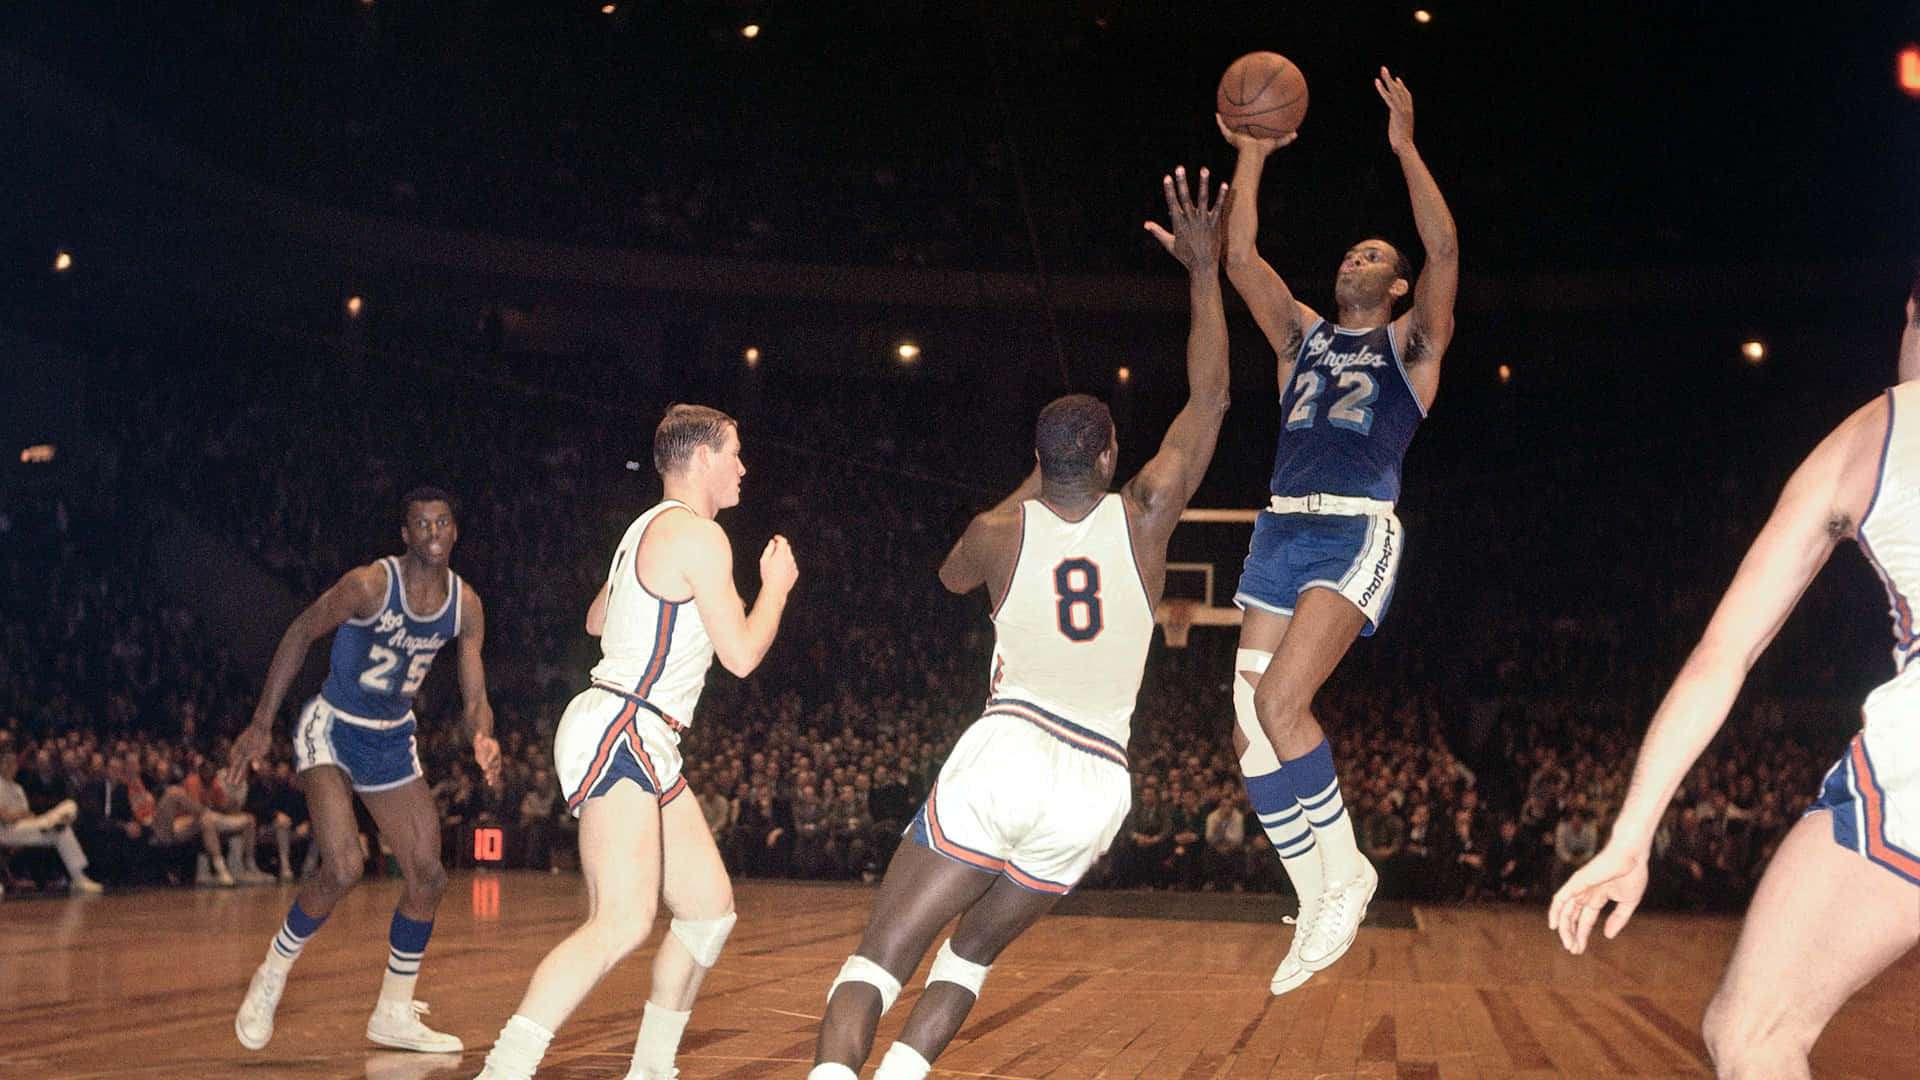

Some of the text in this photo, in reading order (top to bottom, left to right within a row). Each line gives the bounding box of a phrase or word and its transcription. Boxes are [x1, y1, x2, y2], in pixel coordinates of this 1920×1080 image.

[1304, 332, 1333, 360] Los
[1285, 368, 1380, 436] 22
[1358, 518, 1395, 608] LAKERS
[375, 608, 404, 633] Los
[1053, 556, 1104, 643] 8
[359, 644, 434, 697] 25
[474, 828, 503, 861] 10
